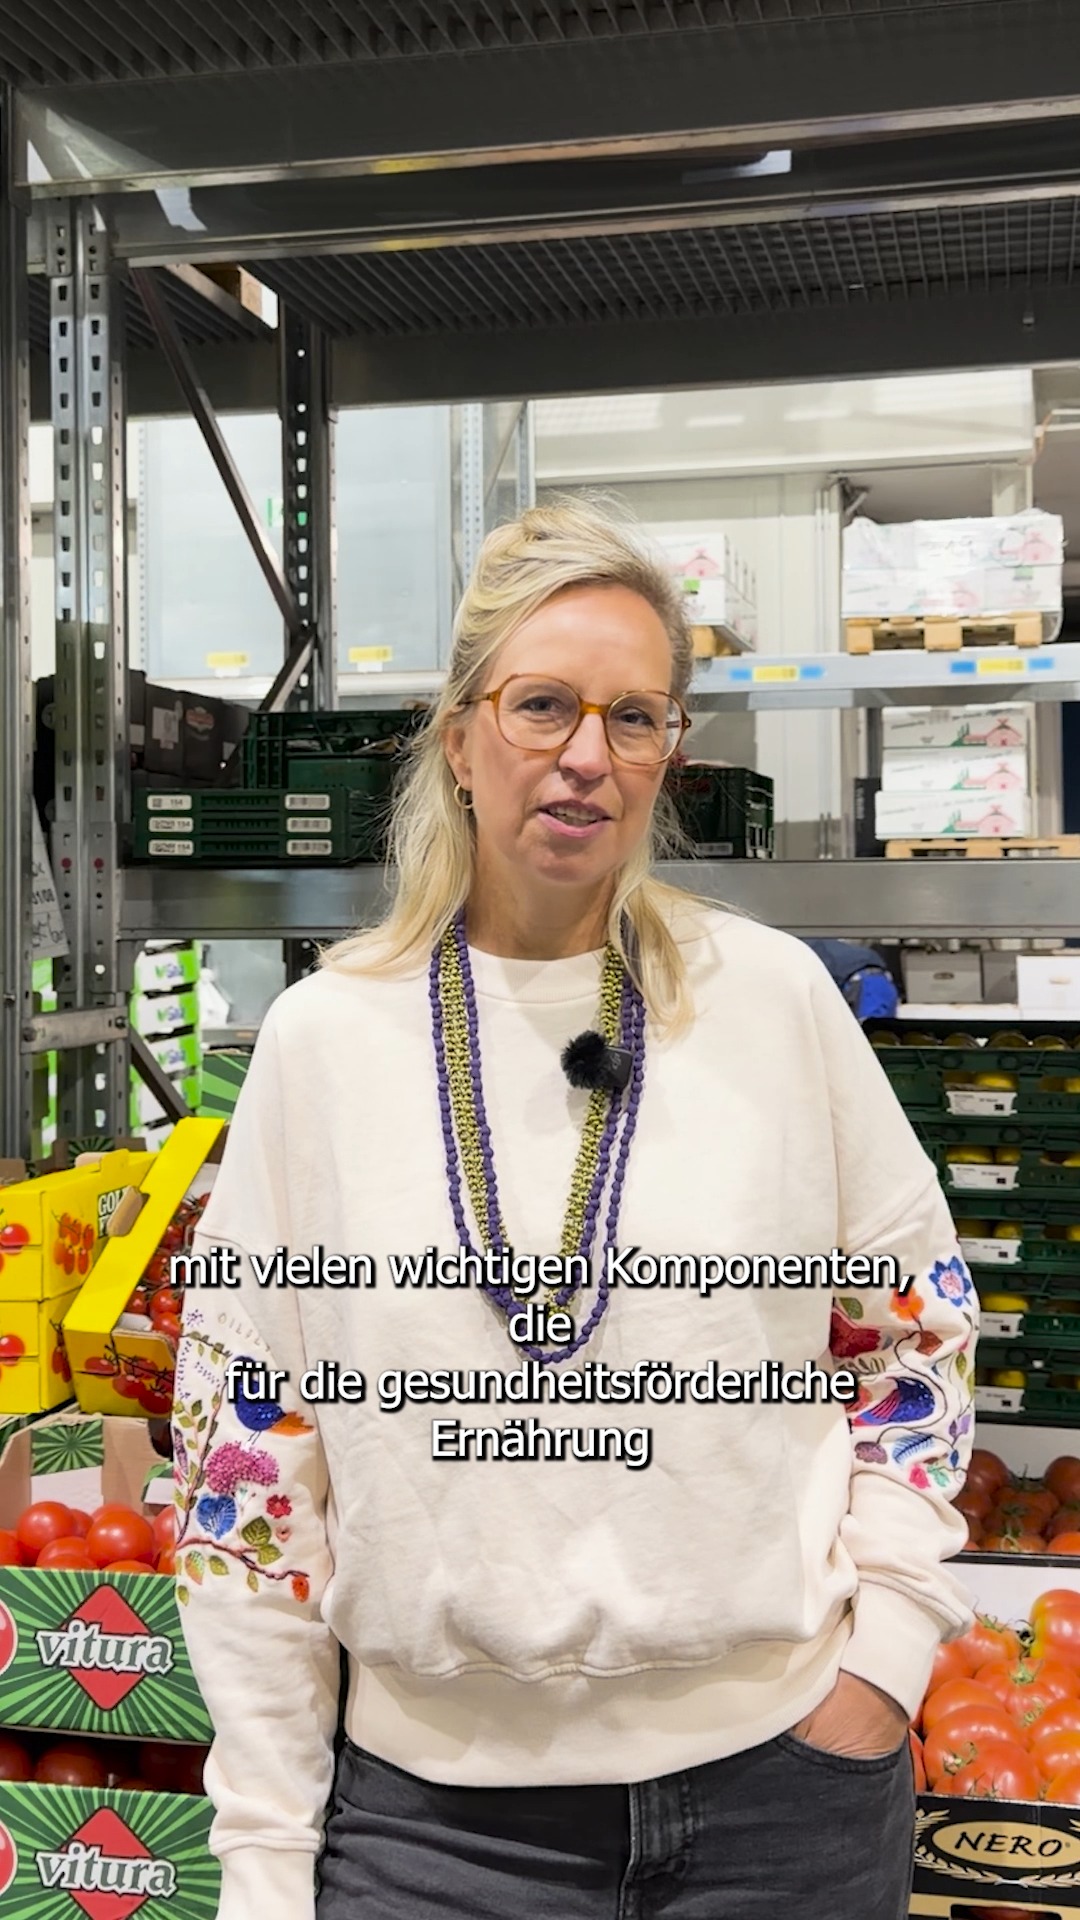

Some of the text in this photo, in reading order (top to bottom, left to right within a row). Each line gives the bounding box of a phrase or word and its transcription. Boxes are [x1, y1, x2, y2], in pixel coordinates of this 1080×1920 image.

[37, 1621, 172, 1673] vitura
[37, 1843, 176, 1897] vitura
[954, 1831, 1062, 1857] NERO
